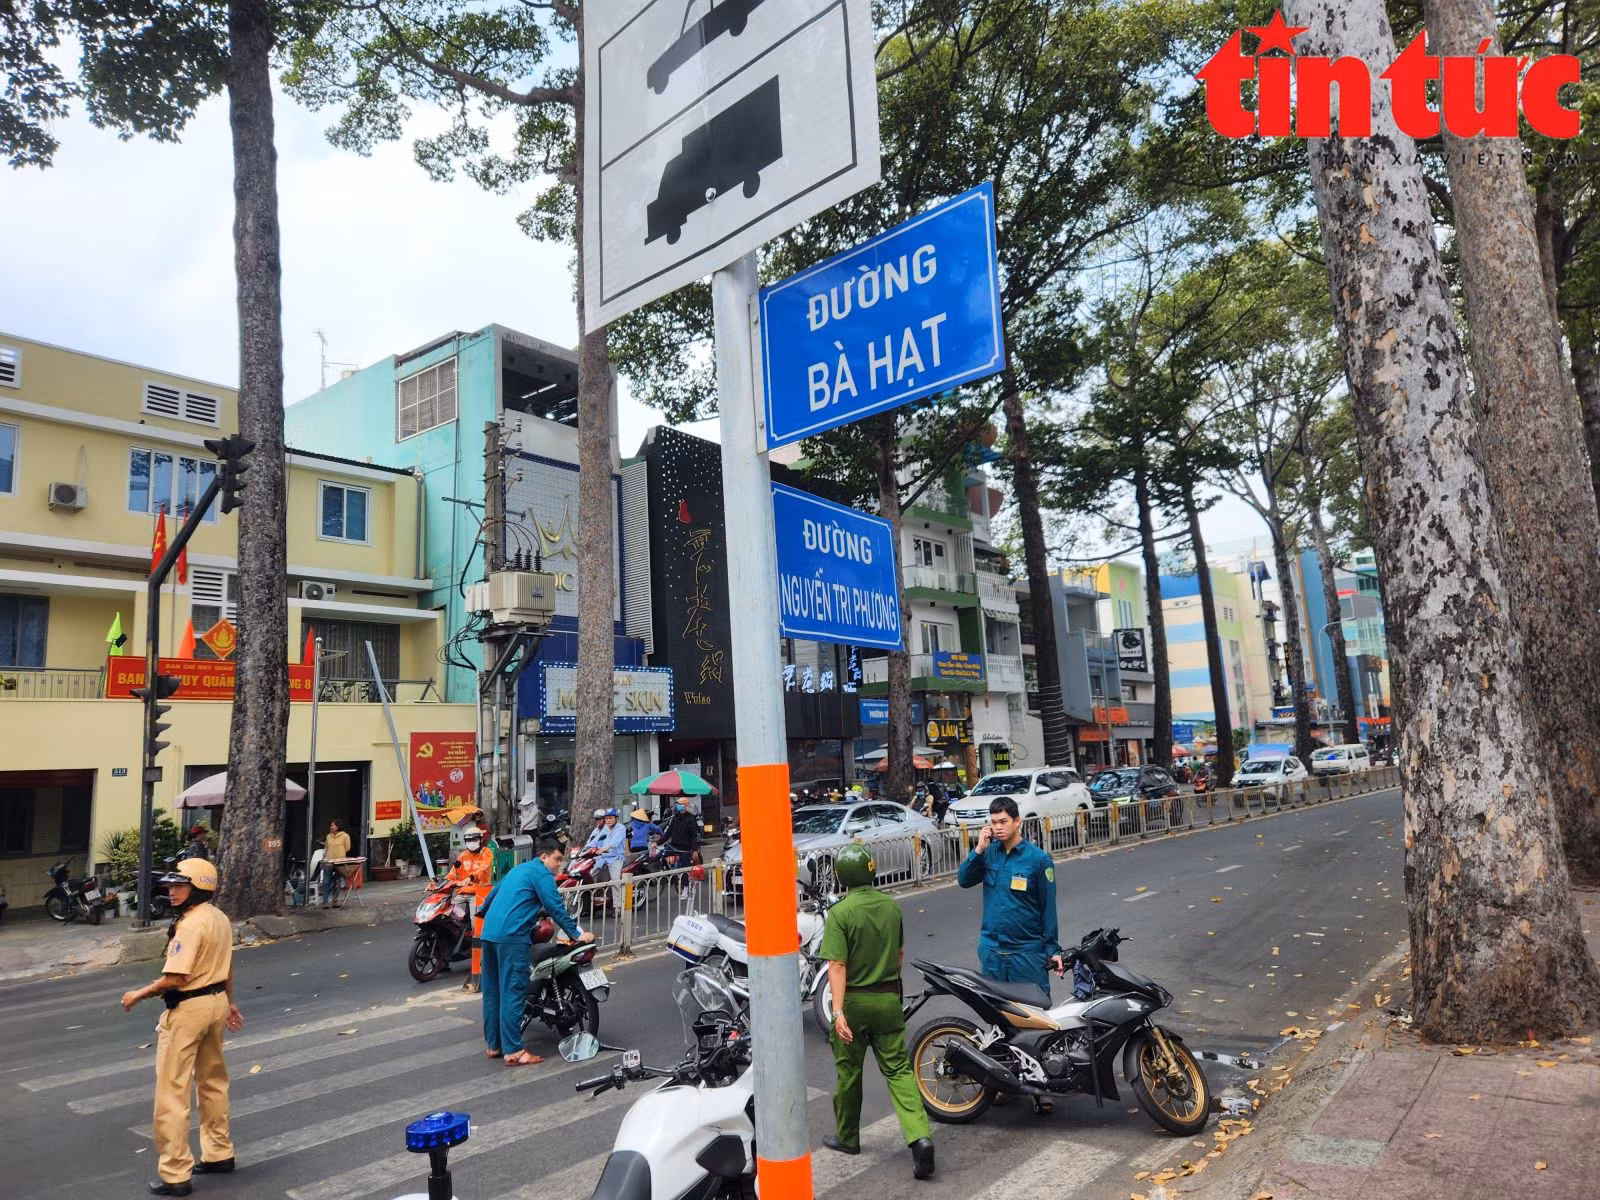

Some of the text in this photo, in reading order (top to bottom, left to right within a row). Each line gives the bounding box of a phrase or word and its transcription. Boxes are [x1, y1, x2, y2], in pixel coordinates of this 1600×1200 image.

[806, 244, 937, 332] ĐƯỜNG
[808, 312, 947, 413] BÀ HẠT
[803, 518, 872, 565] ĐƯỜNG
[781, 568, 896, 632] NGUYỄN TRI PHƯƠNG
[118, 673, 144, 685] BAN
[304, 679, 311, 689] 8
[625, 691, 664, 714] SKIN
